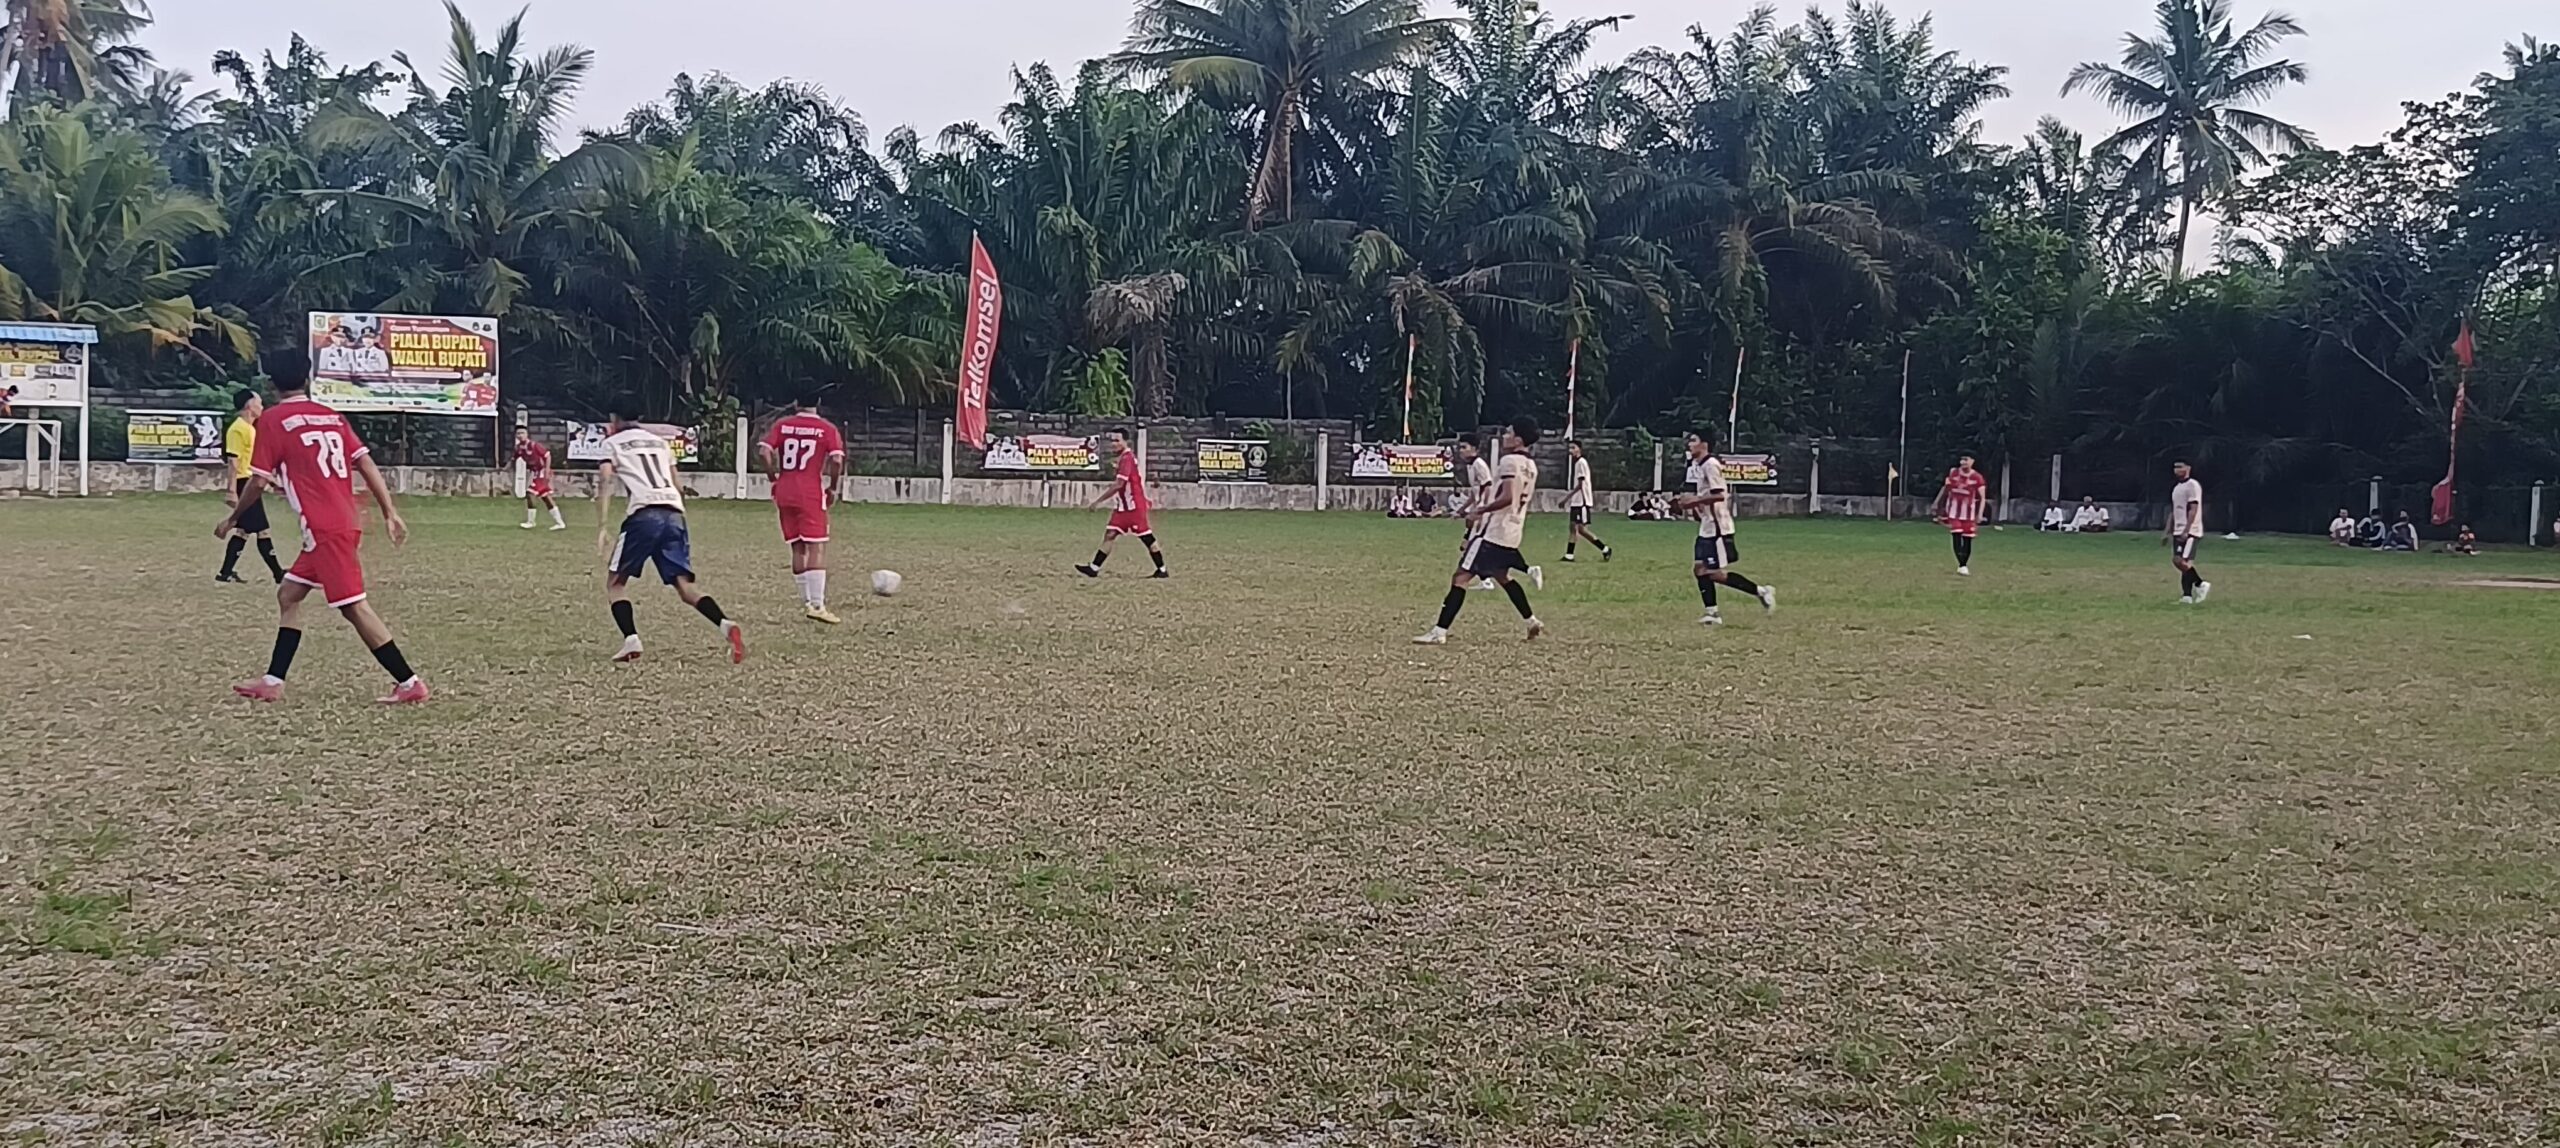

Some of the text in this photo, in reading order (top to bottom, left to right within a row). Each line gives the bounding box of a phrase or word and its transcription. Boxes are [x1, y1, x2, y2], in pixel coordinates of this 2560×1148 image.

[390, 332, 430, 349] PIALA
[964, 269, 997, 409] Telkomsel
[391, 349, 487, 368] WAKIL BUPATI
[156, 424, 189, 436] BUPATI
[160, 435, 193, 446] BUPATI
[300, 430, 348, 479] 78
[783, 438, 817, 470] 87
[1027, 449, 1087, 458] PIALA BUPATI
[1219, 452, 1242, 461] BUPATI
[1028, 457, 1055, 465] WAKIL
[1056, 457, 1088, 465] BUPATI
[1221, 460, 1245, 469] BUPATI
[1389, 457, 1443, 466] PIALA BUPATI
[637, 453, 671, 489] 11
[1389, 465, 1444, 473] WAKIL BUPATI
